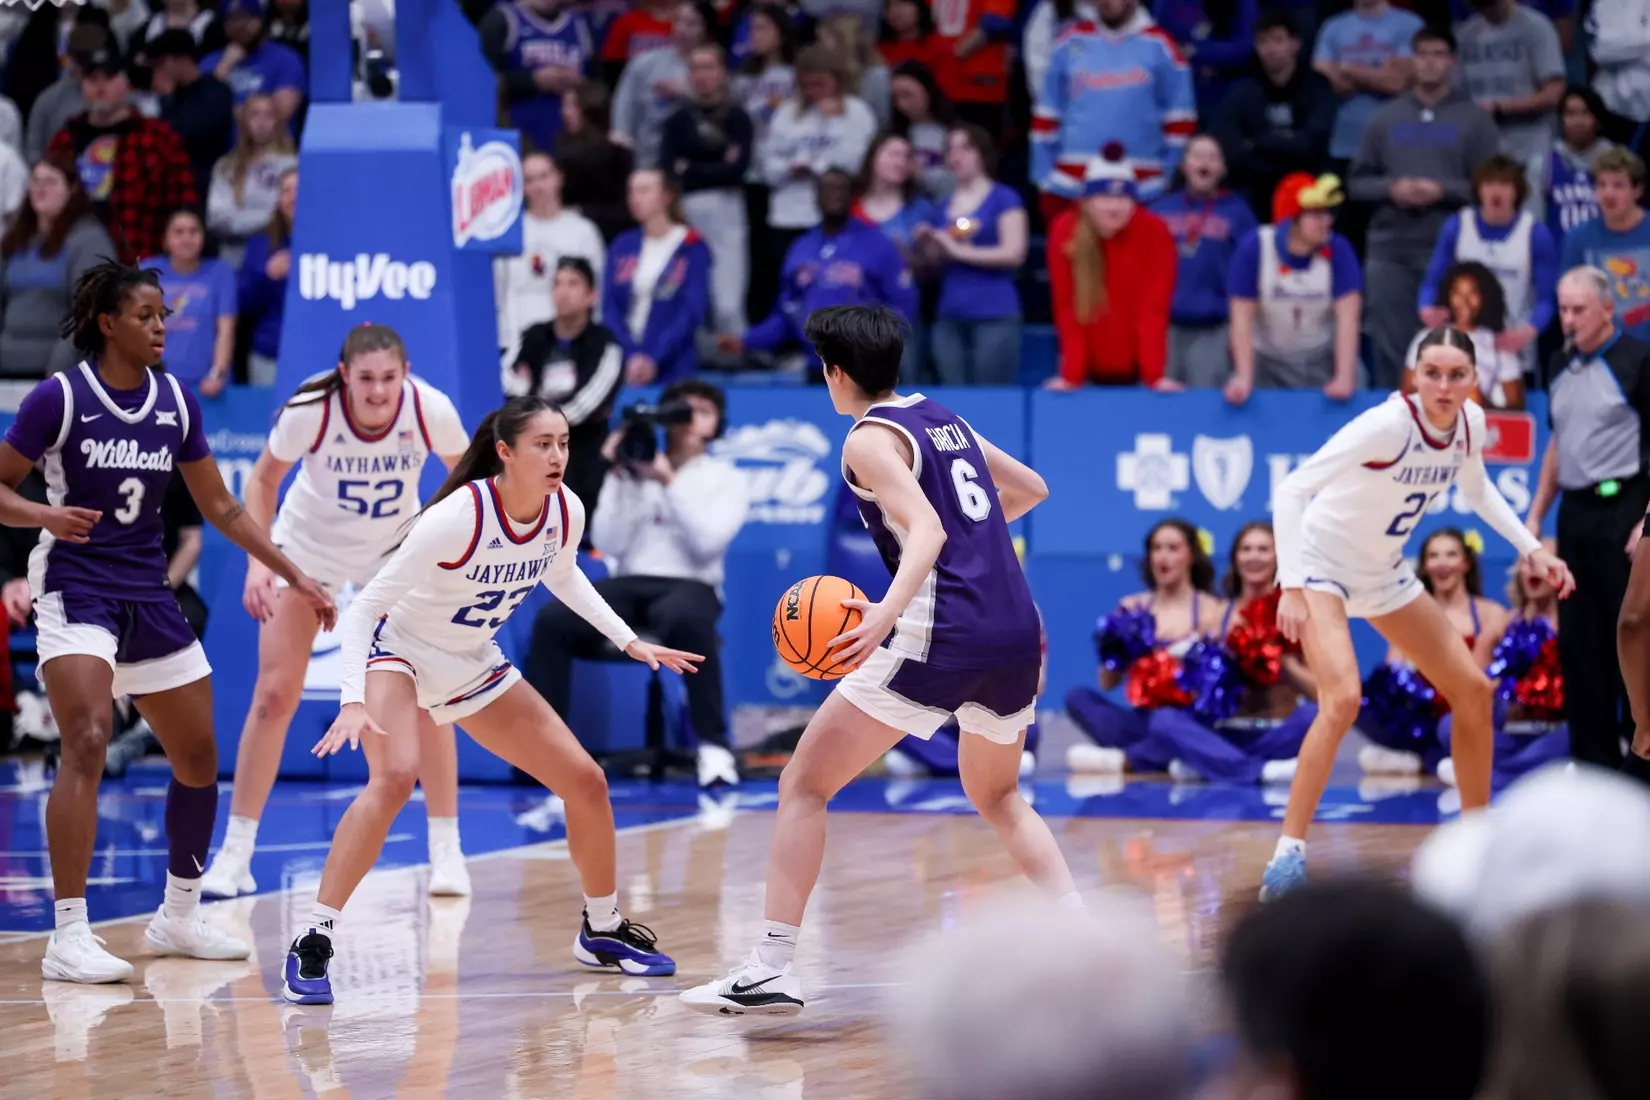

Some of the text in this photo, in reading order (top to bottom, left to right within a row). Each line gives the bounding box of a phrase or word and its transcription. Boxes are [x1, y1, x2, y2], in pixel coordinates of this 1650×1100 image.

[81, 438, 173, 472] Wildcats
[925, 423, 971, 452] GARCIA
[325, 451, 421, 474] JAYHAWKS
[115, 477, 146, 525] 3
[337, 479, 404, 519] 52
[950, 458, 992, 523] 6
